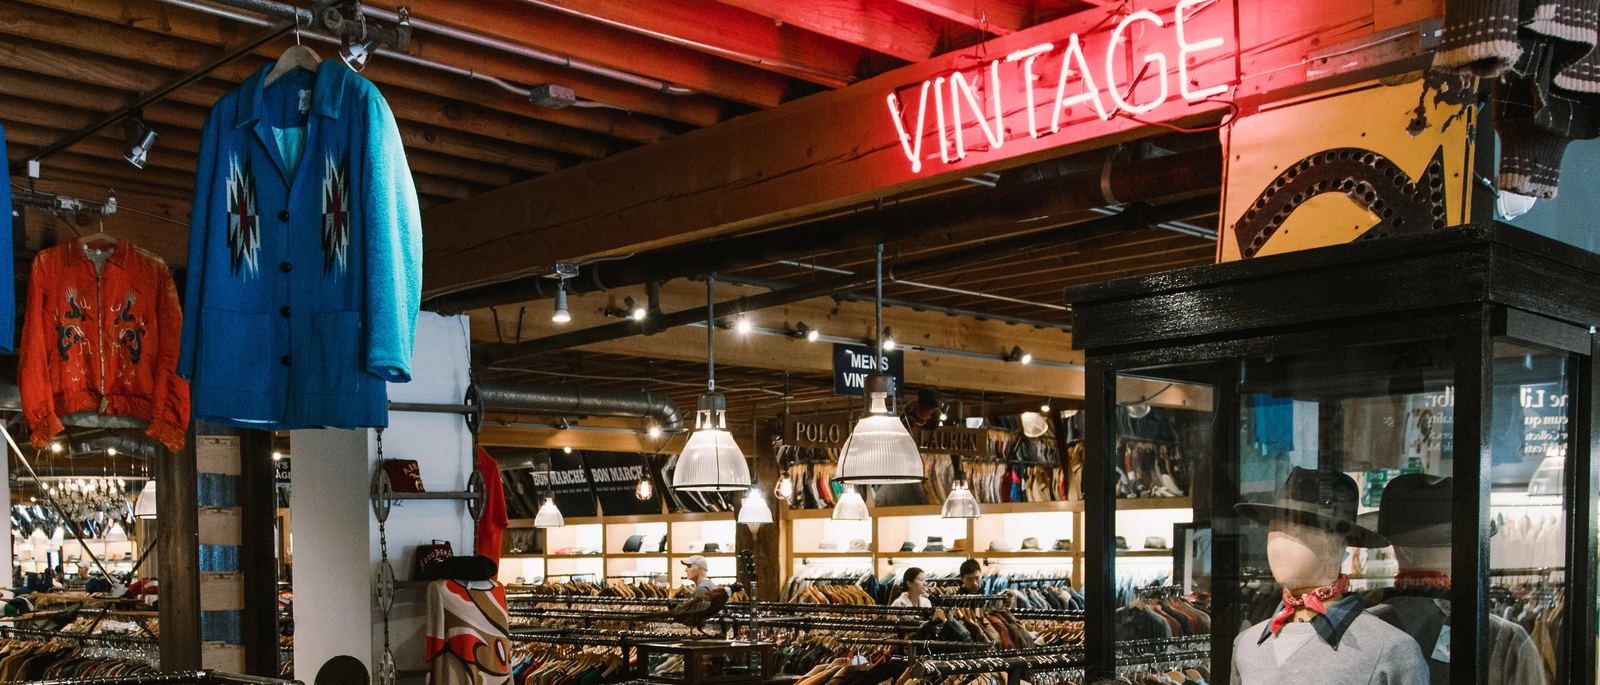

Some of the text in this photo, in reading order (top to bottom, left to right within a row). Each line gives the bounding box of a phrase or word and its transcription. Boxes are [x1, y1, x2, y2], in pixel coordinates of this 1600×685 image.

[887, 0, 1230, 173] VINTAGE
[851, 353, 889, 371] MENS
[796, 422, 840, 444] POLO
[919, 429, 977, 451] LAUREN
[550, 464, 587, 485] MARCHÉ
[591, 467, 610, 482] BON
